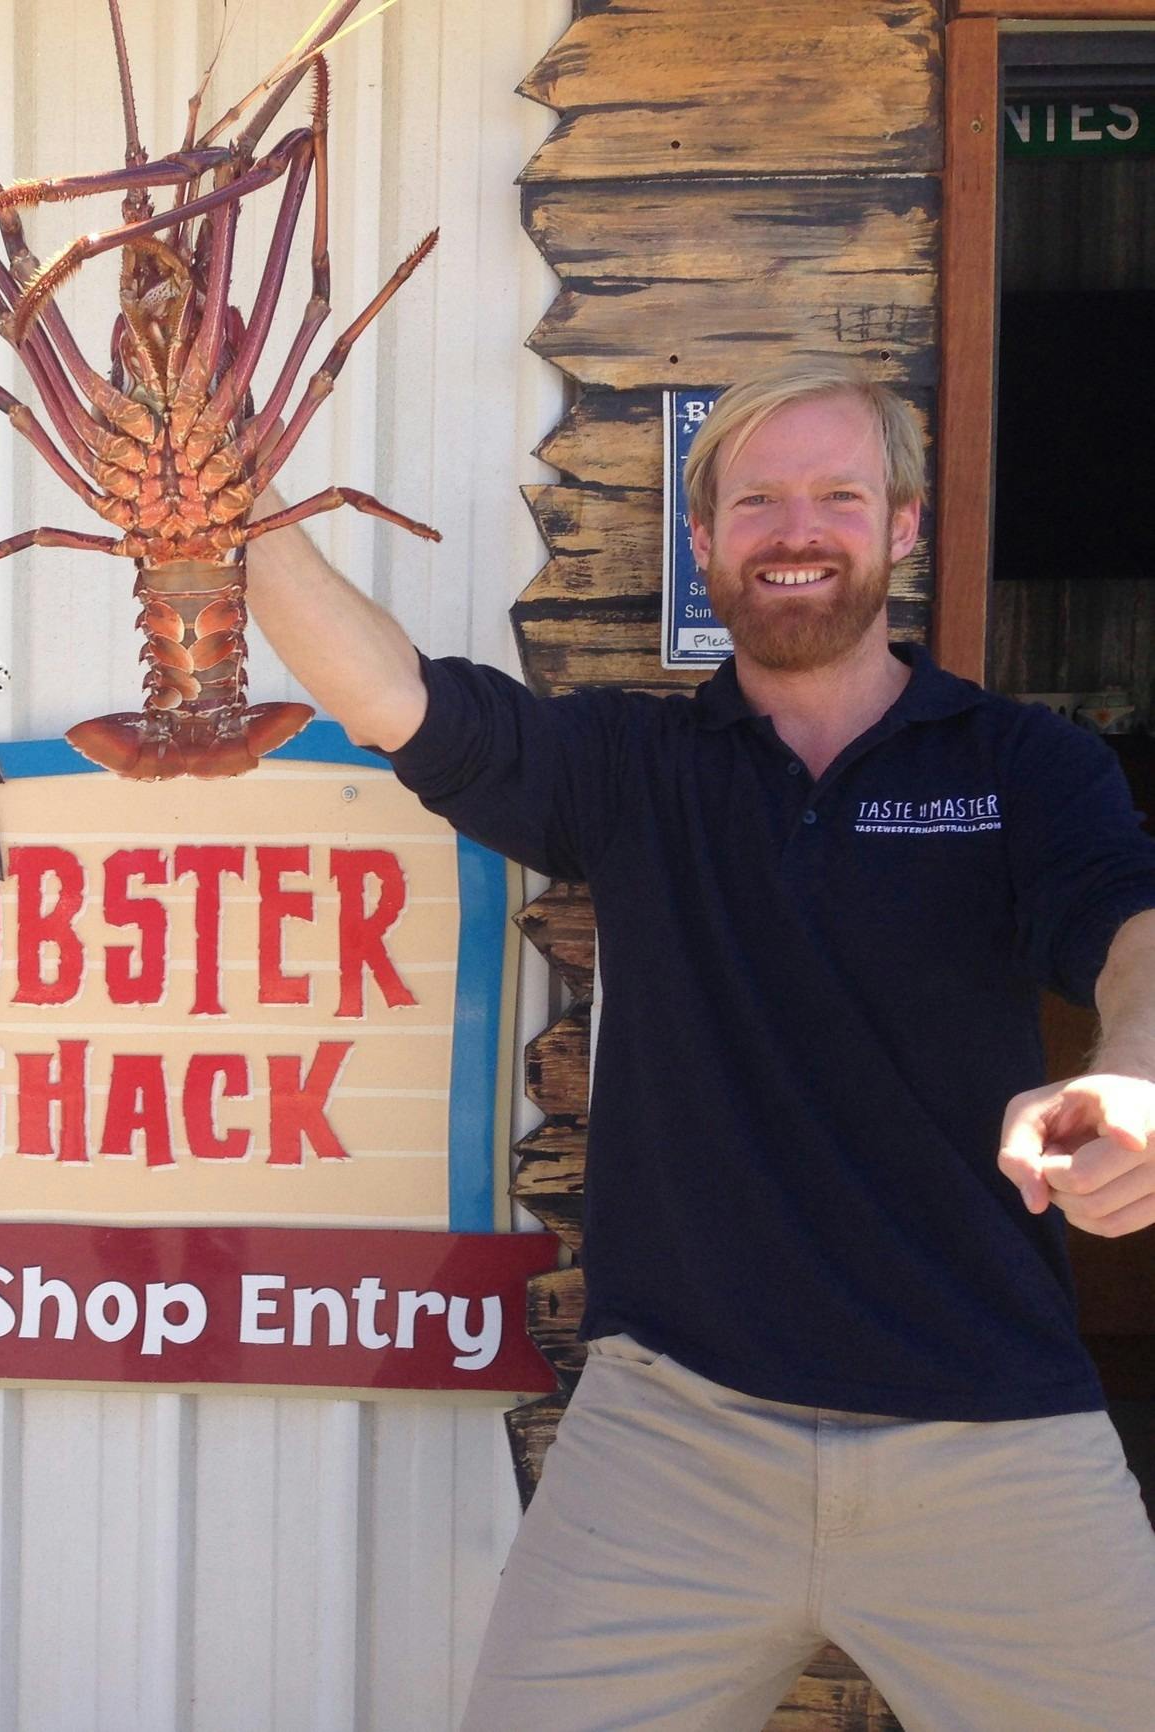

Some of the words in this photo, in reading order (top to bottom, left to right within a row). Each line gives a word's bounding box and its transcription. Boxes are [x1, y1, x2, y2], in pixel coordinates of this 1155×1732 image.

[685, 604, 712, 619] Sun
[858, 800, 913, 819] TASTE
[930, 794, 998, 819] MASTER
[239, 1273, 503, 1371] Entry
